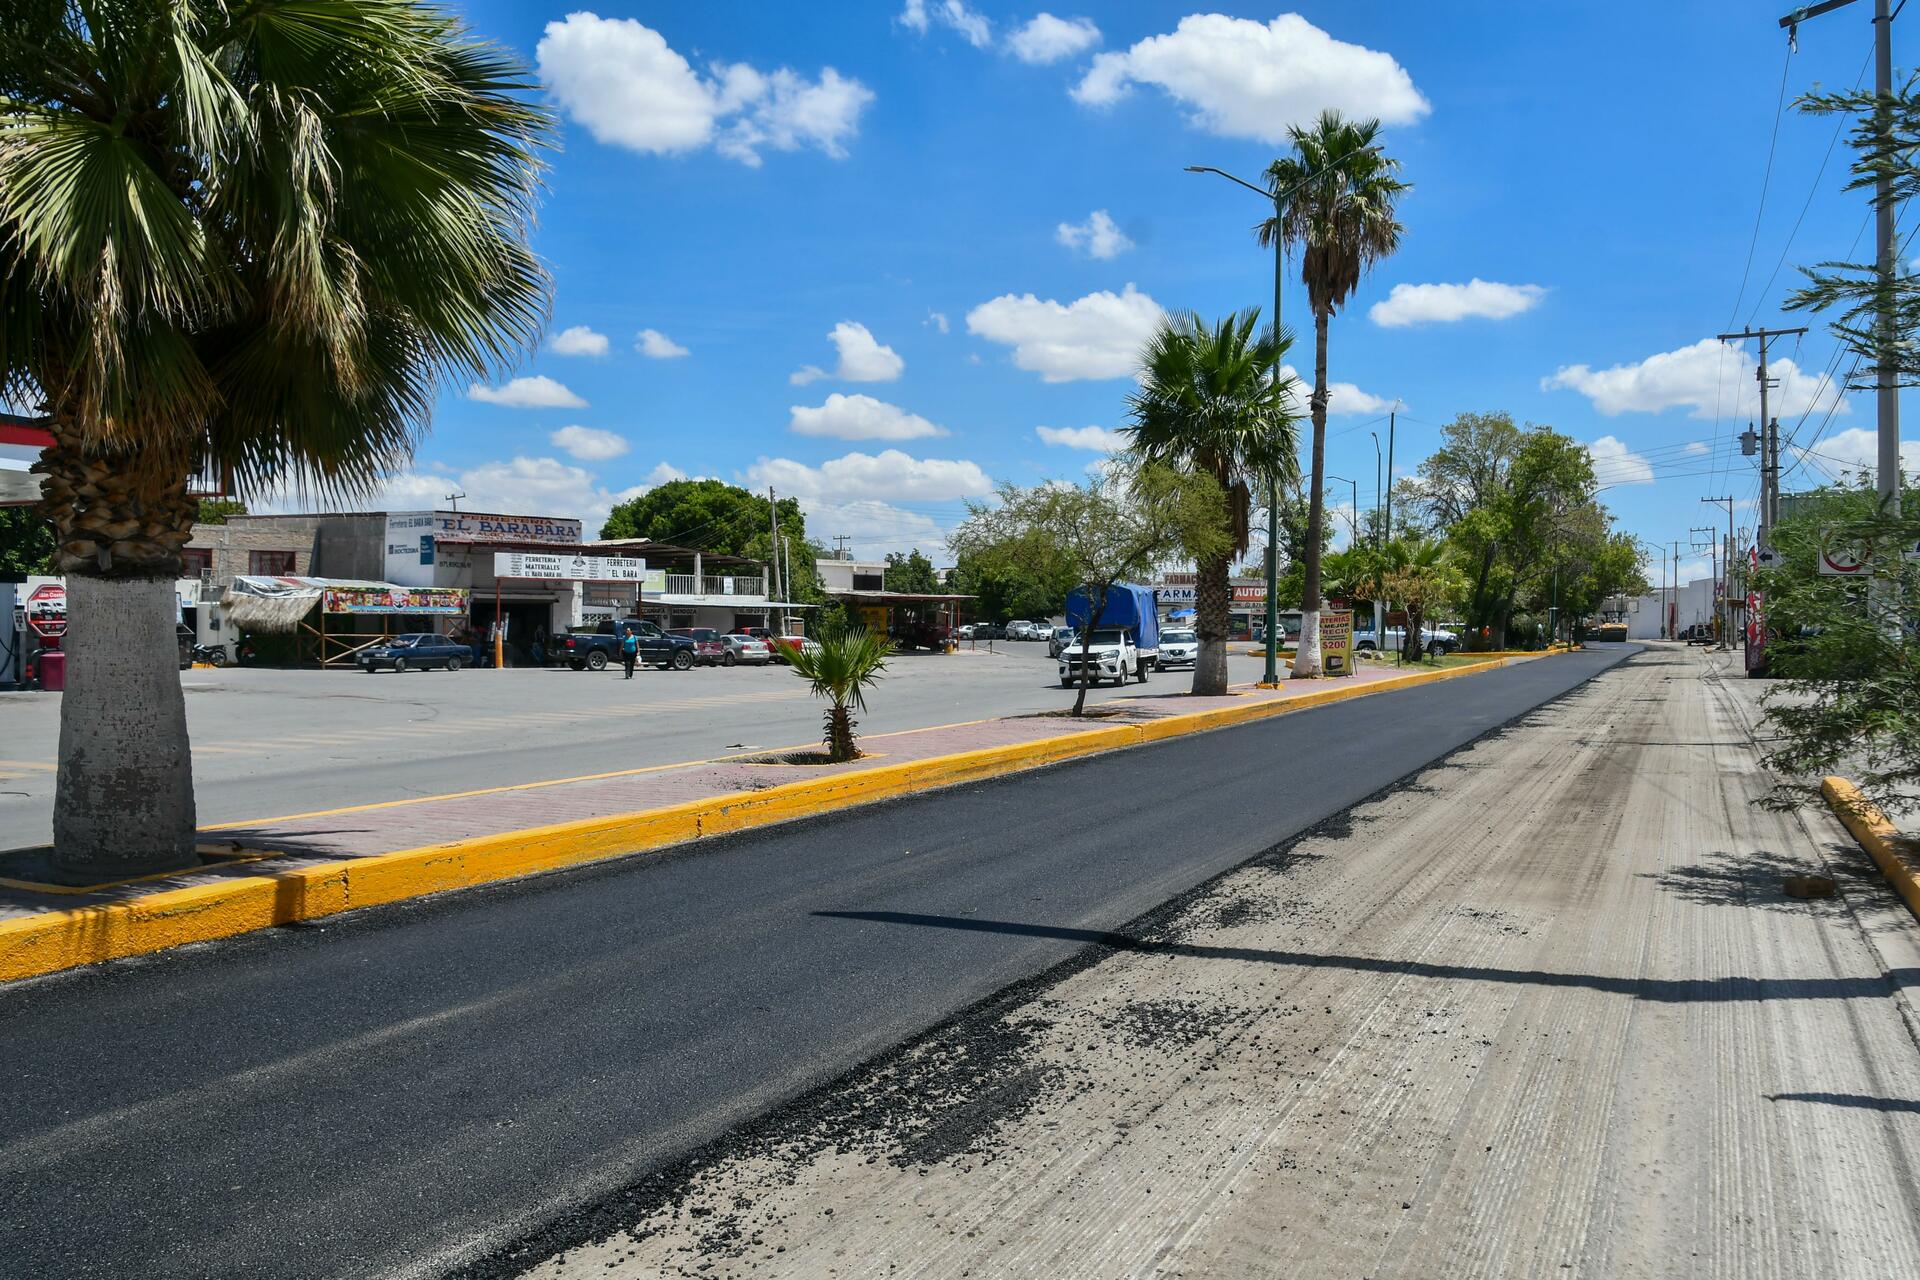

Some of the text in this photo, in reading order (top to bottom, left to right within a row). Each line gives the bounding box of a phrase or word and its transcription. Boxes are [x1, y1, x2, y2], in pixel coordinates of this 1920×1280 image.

[525, 563, 560, 571] MATERIALES
[606, 558, 637, 567] FERRETERIA
[622, 569, 638, 578] BARA
[1320, 614, 1350, 624] ATERIAS
[1322, 640, 1346, 650] $200
